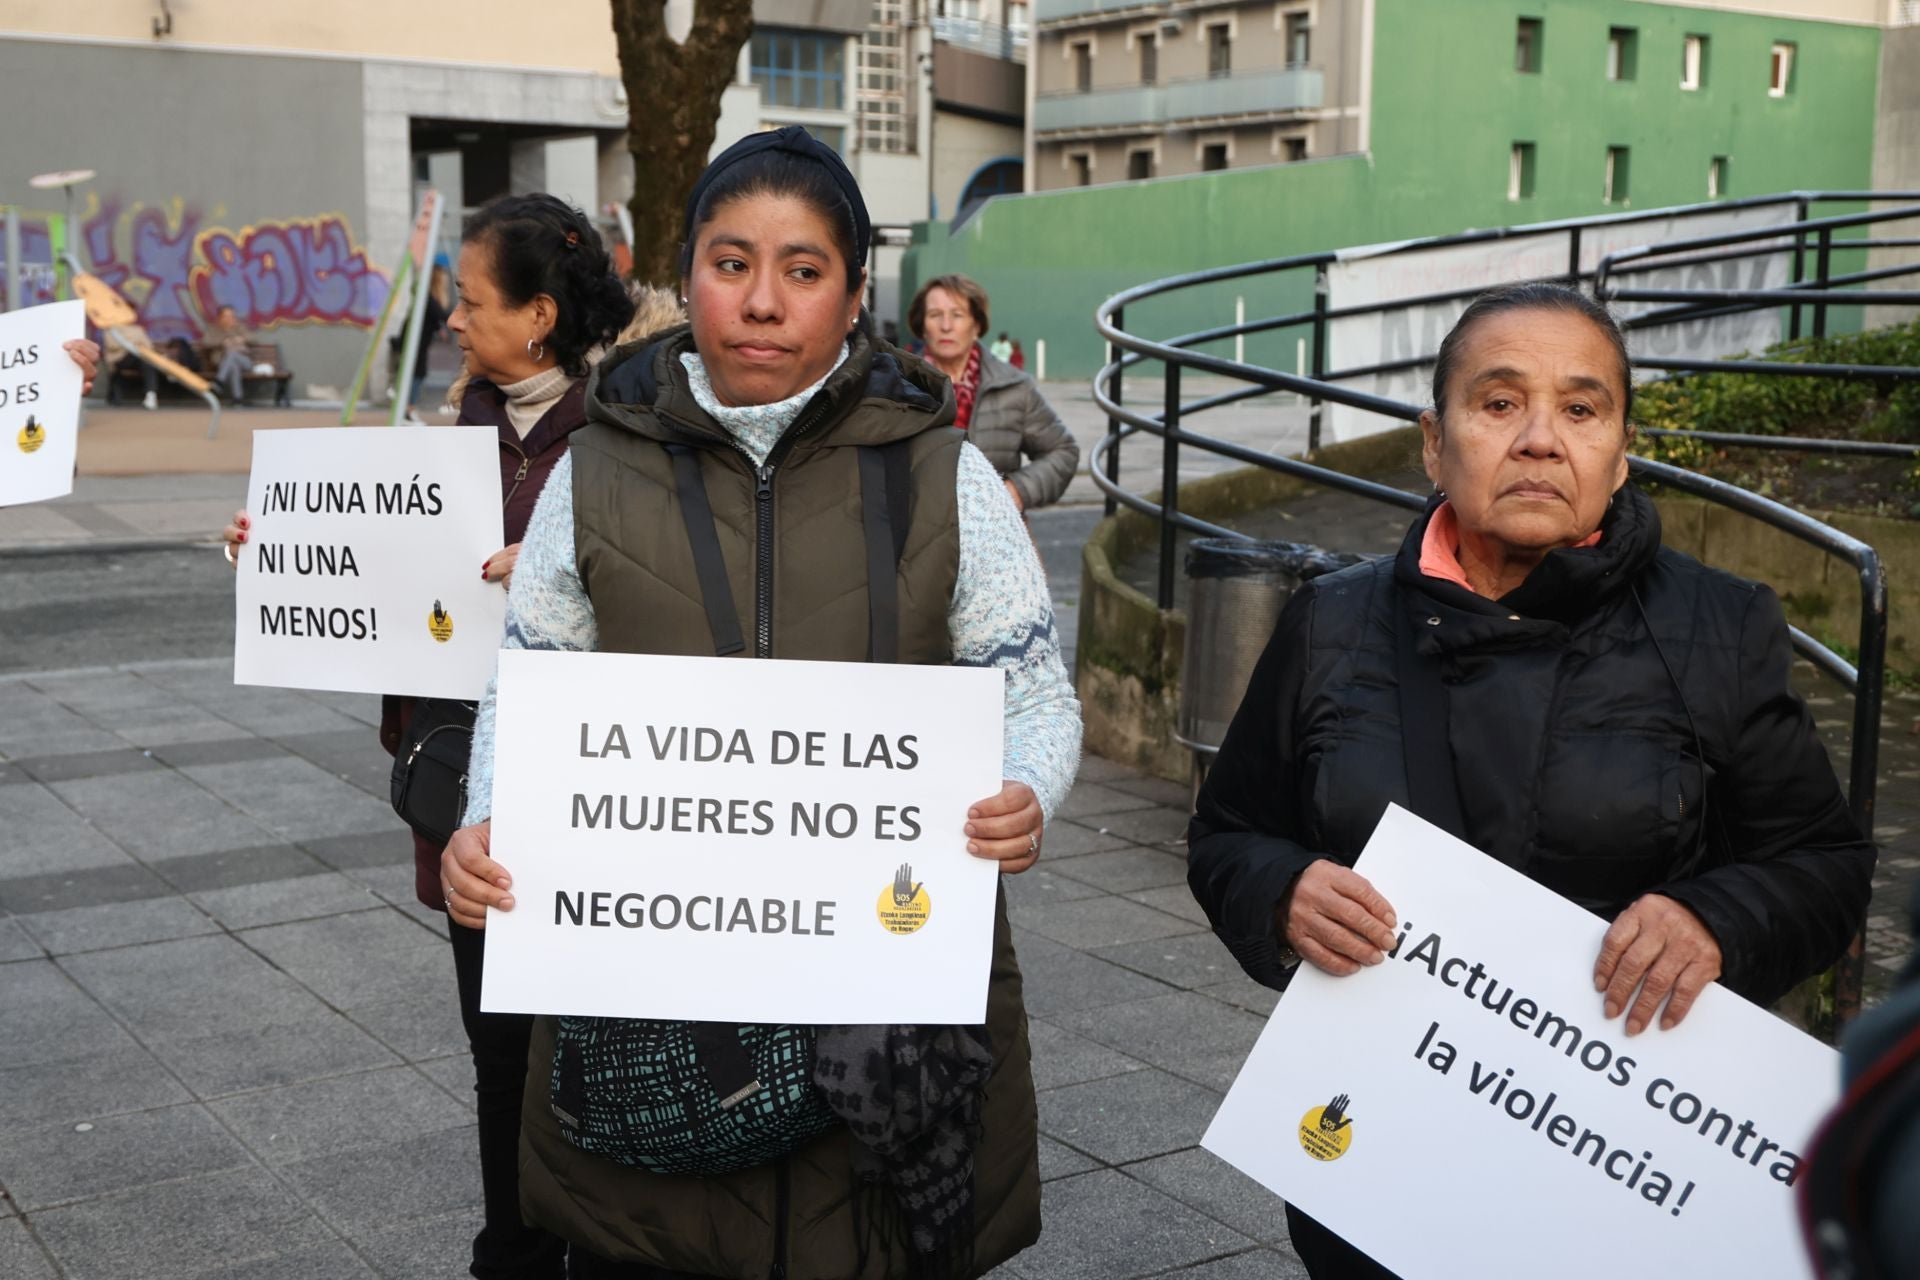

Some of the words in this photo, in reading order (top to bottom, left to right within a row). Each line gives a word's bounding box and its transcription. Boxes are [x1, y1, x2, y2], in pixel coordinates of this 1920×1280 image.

[1, 344, 38, 370] LAS
[16, 382, 40, 404] ES
[262, 481, 297, 516] ¡NI
[305, 481, 366, 514] UNA
[375, 473, 443, 516] MÁS
[258, 543, 285, 574] NI
[294, 544, 360, 577] UNA
[260, 604, 378, 641] MENOS!
[579, 722, 632, 760] LA
[646, 725, 755, 764] VIDA
[770, 730, 827, 767] DE
[842, 732, 919, 771] LAS
[571, 793, 774, 836] MUJERES
[790, 801, 858, 839] NO
[874, 804, 922, 842] ES
[554, 890, 837, 936] NEGOCIABLE
[896, 894, 911, 902] SOS
[1388, 921, 1637, 1087] ¡Actuemos
[1645, 1078, 1801, 1188] contra
[1322, 1118, 1336, 1130] SOS
[1414, 1021, 1458, 1076] la
[1468, 1060, 1697, 1217] violencia!
